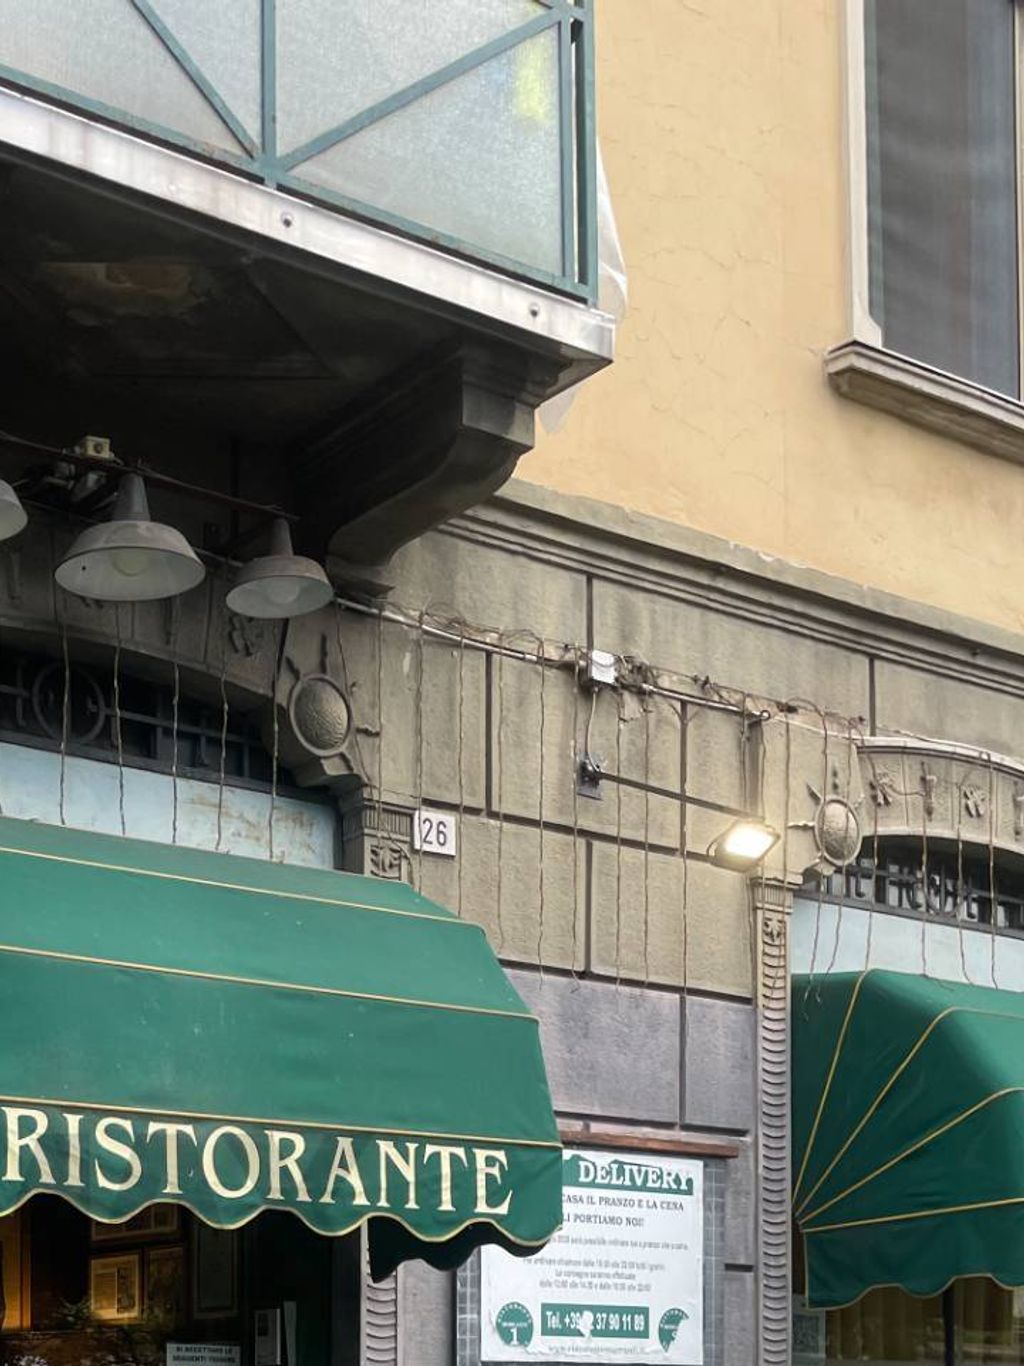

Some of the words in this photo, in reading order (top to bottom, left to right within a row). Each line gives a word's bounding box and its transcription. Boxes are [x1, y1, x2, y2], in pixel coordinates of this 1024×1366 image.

[422, 817, 447, 847] 26
[1, 1106, 513, 1216] RISTORANTE
[578, 1160, 693, 1190] DELIVERY
[586, 1195, 596, 1206] IL
[598, 1196, 635, 1208] PRANZO
[645, 1199, 658, 1210] LA
[660, 1200, 684, 1211] CENA
[573, 1214, 623, 1226] PORTIAMO
[546, 1311, 562, 1329] Tel.
[596, 1312, 607, 1330] 37
[609, 1312, 620, 1331] 90
[622, 1313, 632, 1331] 11
